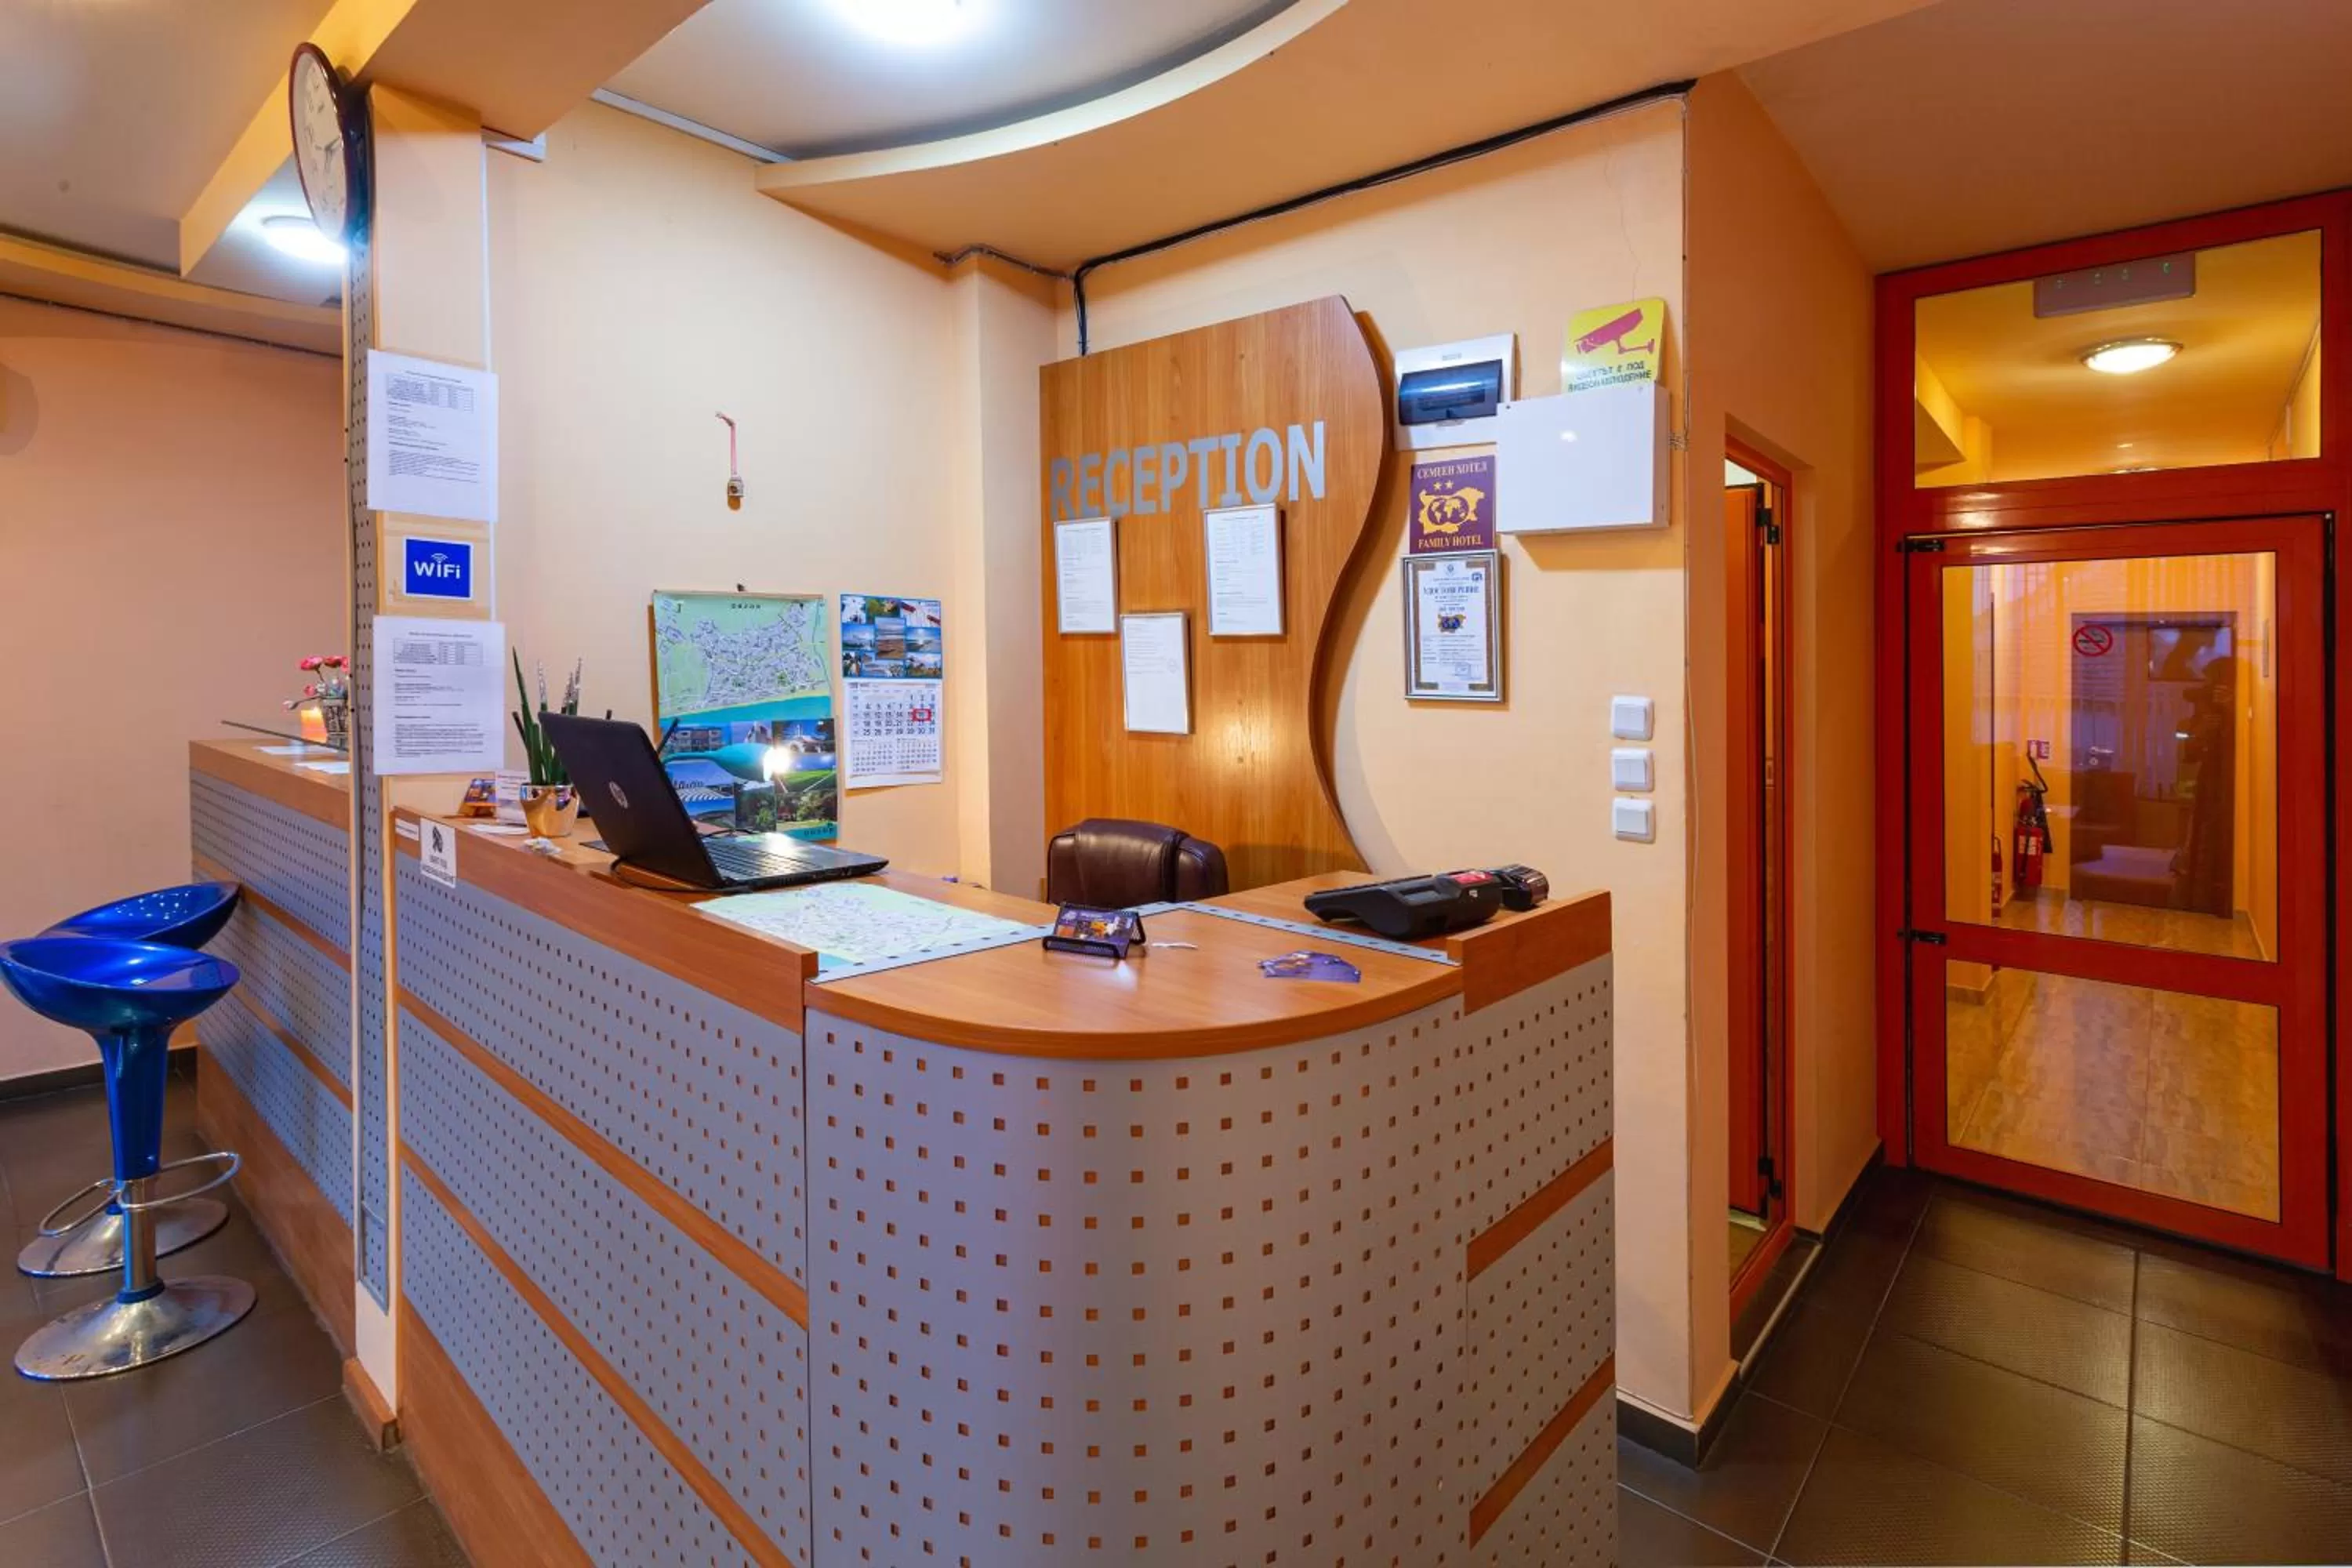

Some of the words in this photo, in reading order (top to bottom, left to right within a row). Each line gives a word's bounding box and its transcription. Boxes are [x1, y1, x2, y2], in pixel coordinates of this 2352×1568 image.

[1626, 360, 1645, 370] ПОД
[1050, 420, 1326, 521] RECEPTION
[1418, 536, 1451, 549] FAMILY
[1452, 534, 1484, 546] HOTEL
[413, 557, 462, 579] WiFi
